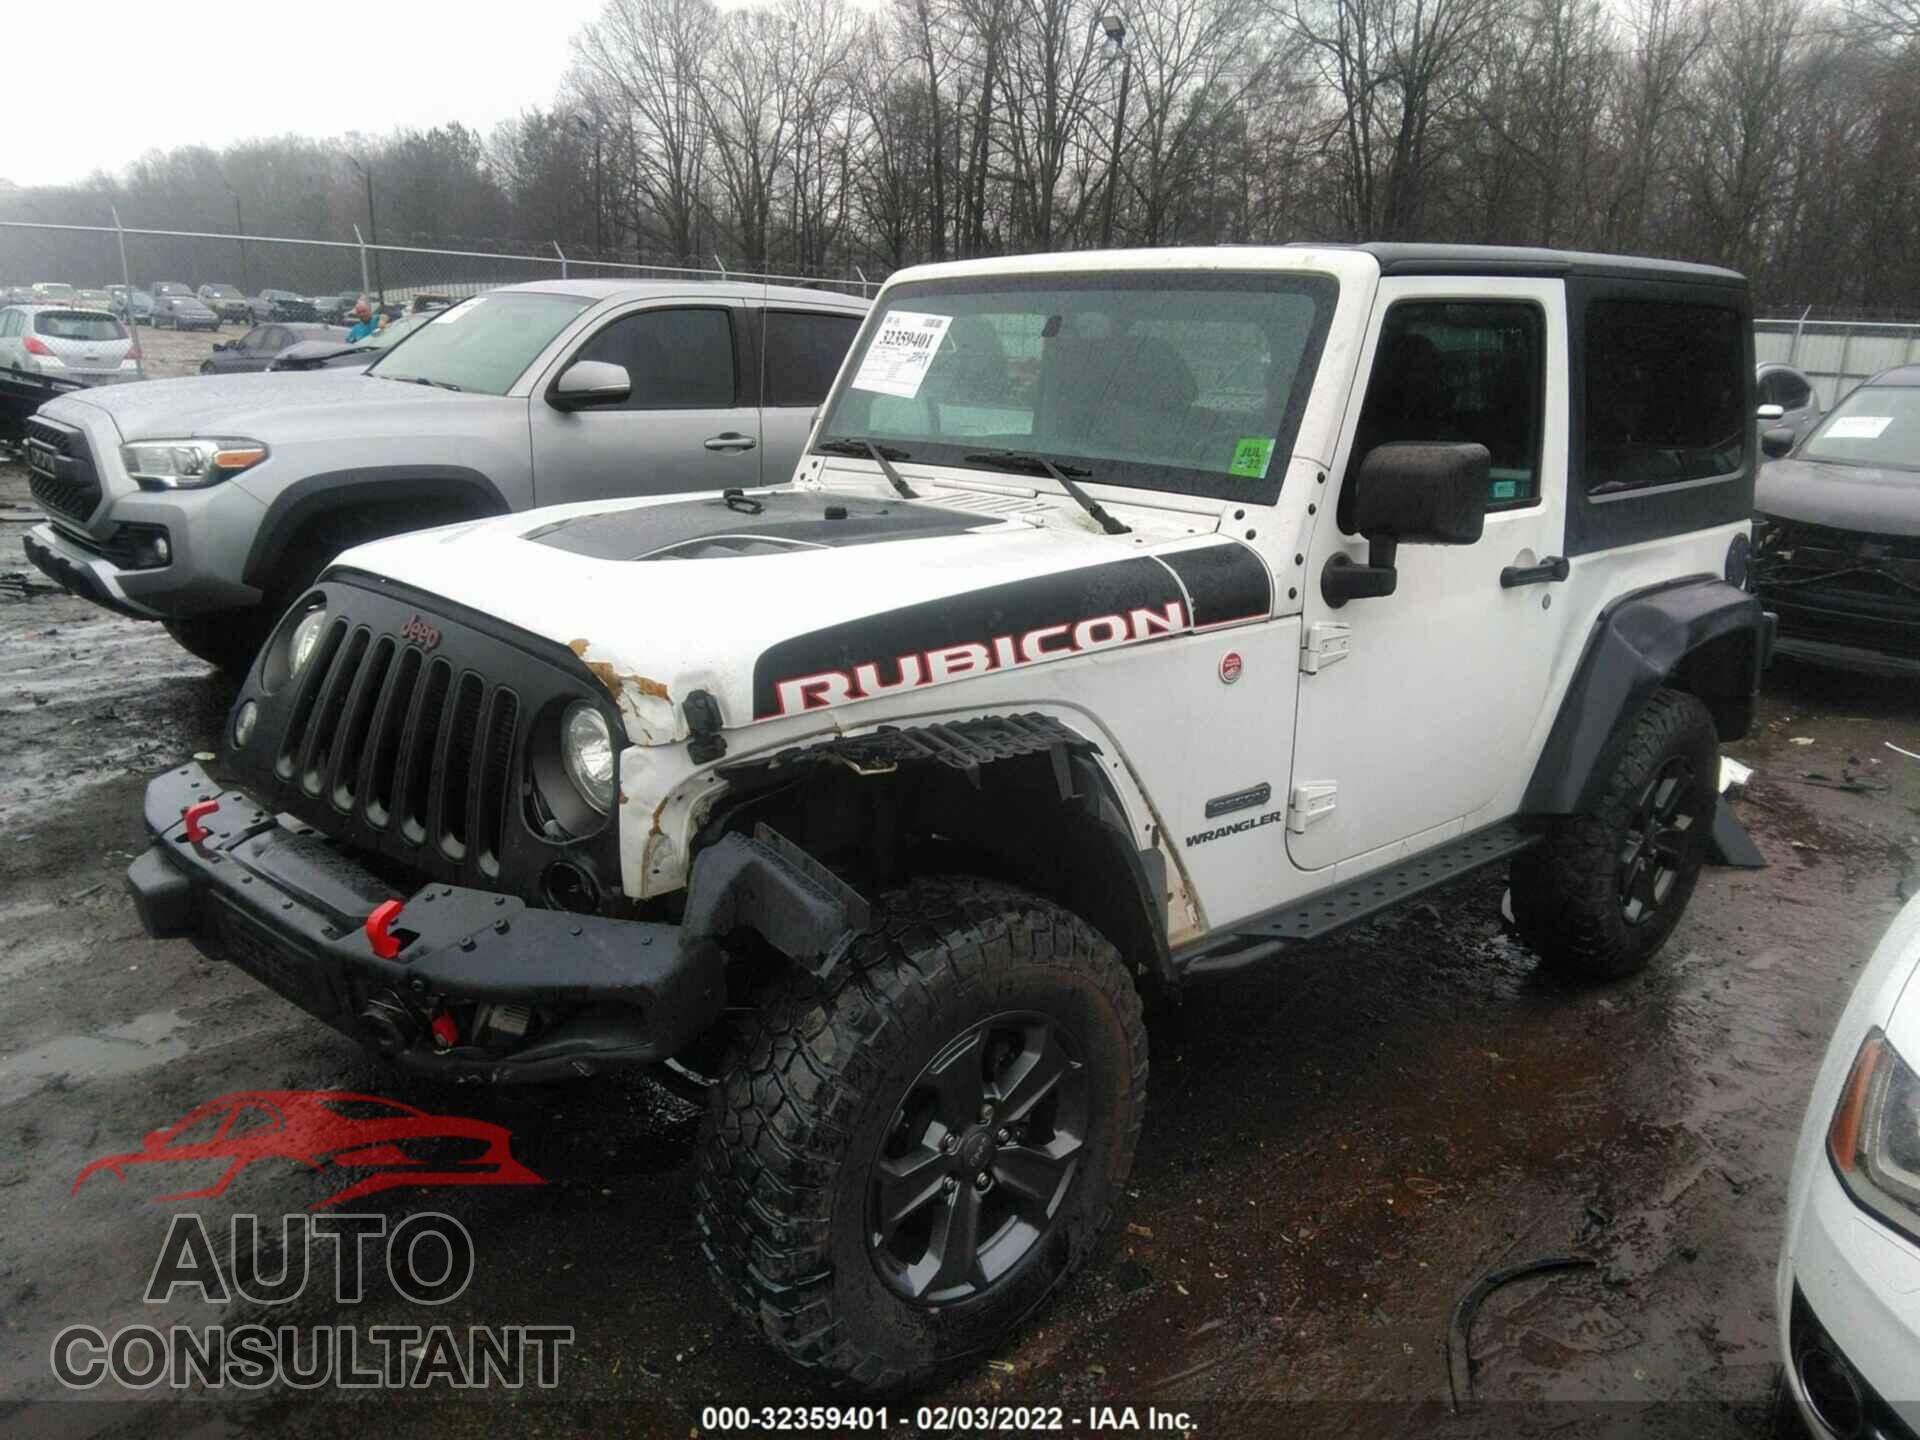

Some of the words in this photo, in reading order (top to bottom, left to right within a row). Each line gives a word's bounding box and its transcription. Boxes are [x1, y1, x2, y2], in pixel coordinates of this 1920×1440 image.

[879, 330, 935, 349] 32359401
[775, 601, 1188, 716] RUBICON
[1186, 811, 1281, 847] WRANGLER
